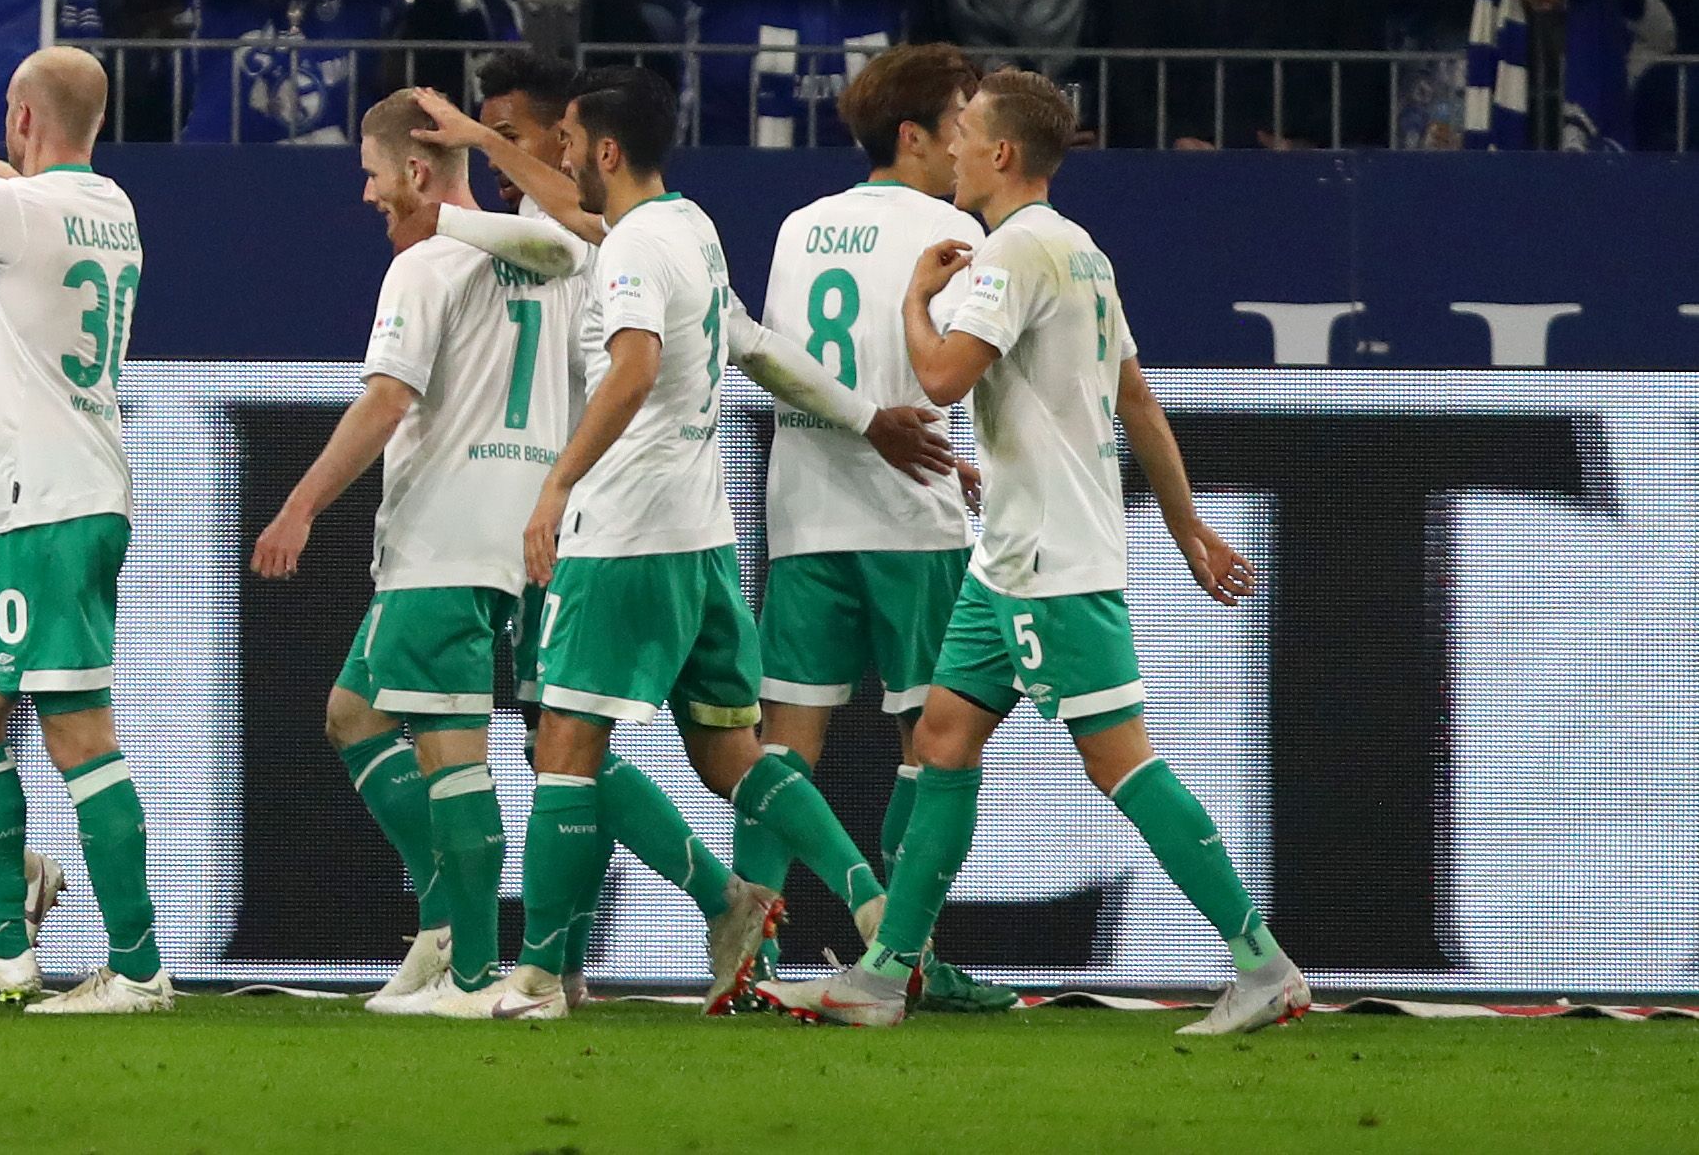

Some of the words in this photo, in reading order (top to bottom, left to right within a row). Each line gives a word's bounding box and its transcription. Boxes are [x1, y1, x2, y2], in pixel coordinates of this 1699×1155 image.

[806, 225, 880, 255] OSAKO
[806, 268, 861, 391] 8
[468, 442, 522, 461] WERDER
[524, 446, 559, 466] BREM
[1013, 613, 1043, 670] 5
[558, 823, 597, 834] WERD
